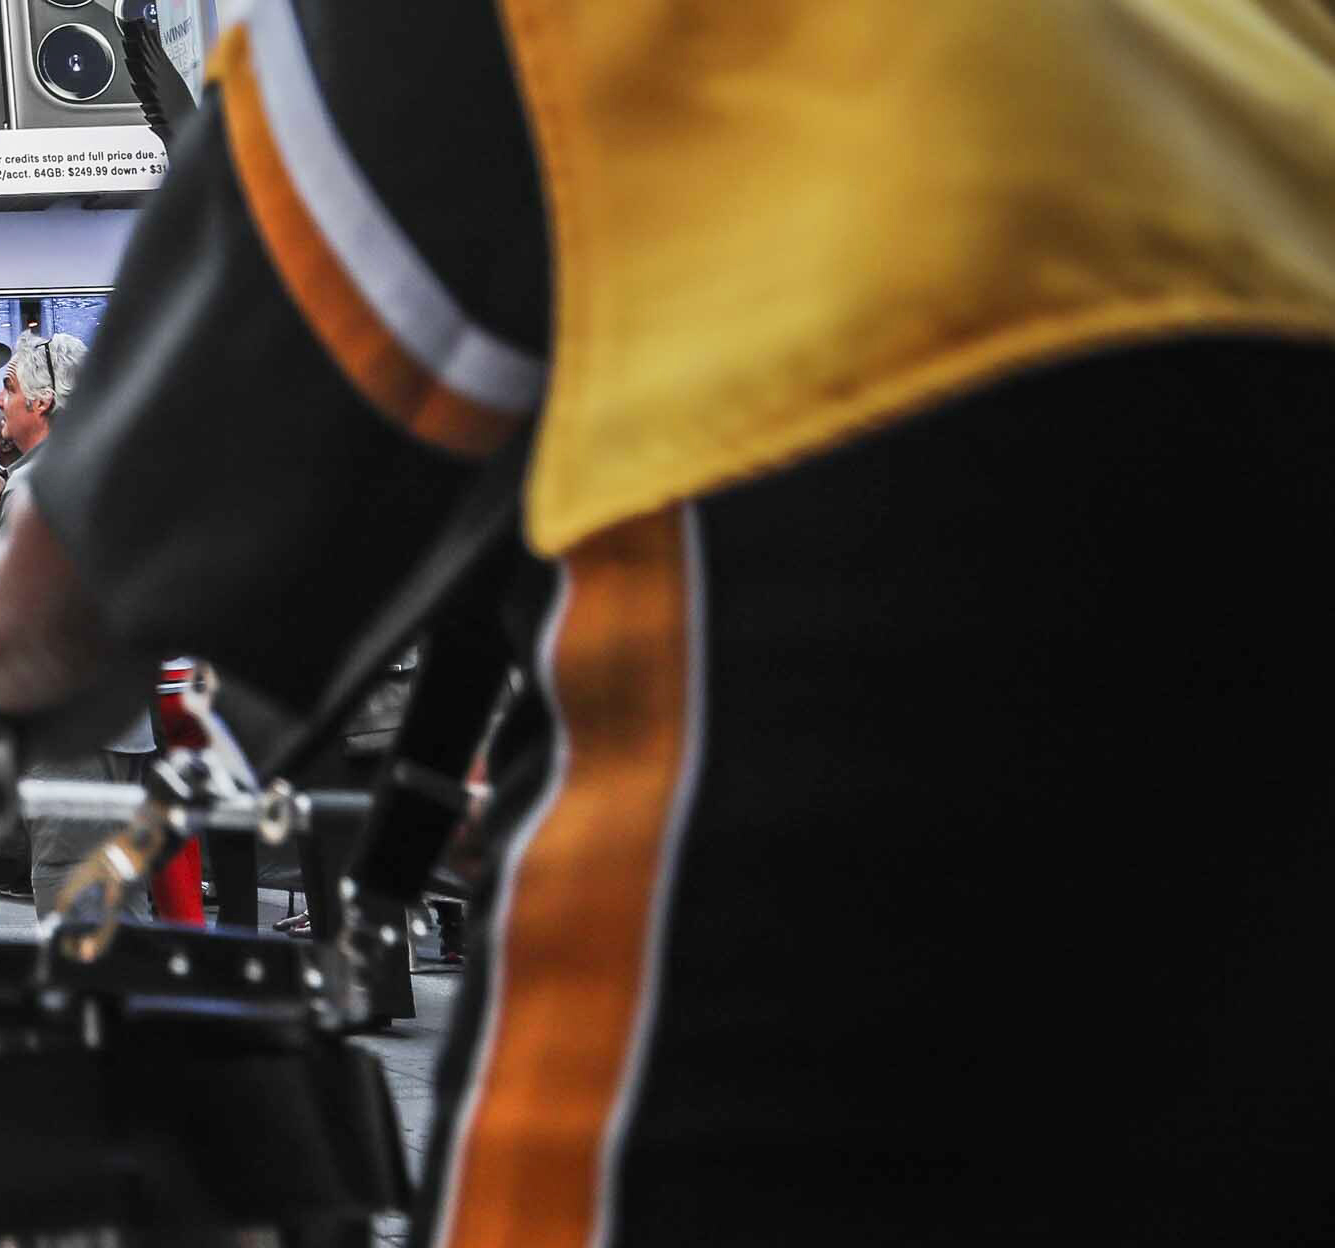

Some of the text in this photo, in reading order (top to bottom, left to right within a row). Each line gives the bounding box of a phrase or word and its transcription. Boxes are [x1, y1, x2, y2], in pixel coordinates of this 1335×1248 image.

[5, 153, 40, 165] credits
[42, 154, 64, 165] stop
[67, 152, 85, 162] and
[88, 150, 104, 162] full
[107, 150, 133, 163] price
[135, 149, 158, 160] due.
[34, 167, 65, 179] 64GB:
[68, 166, 108, 178] $249.99
[111, 165, 138, 176] down
